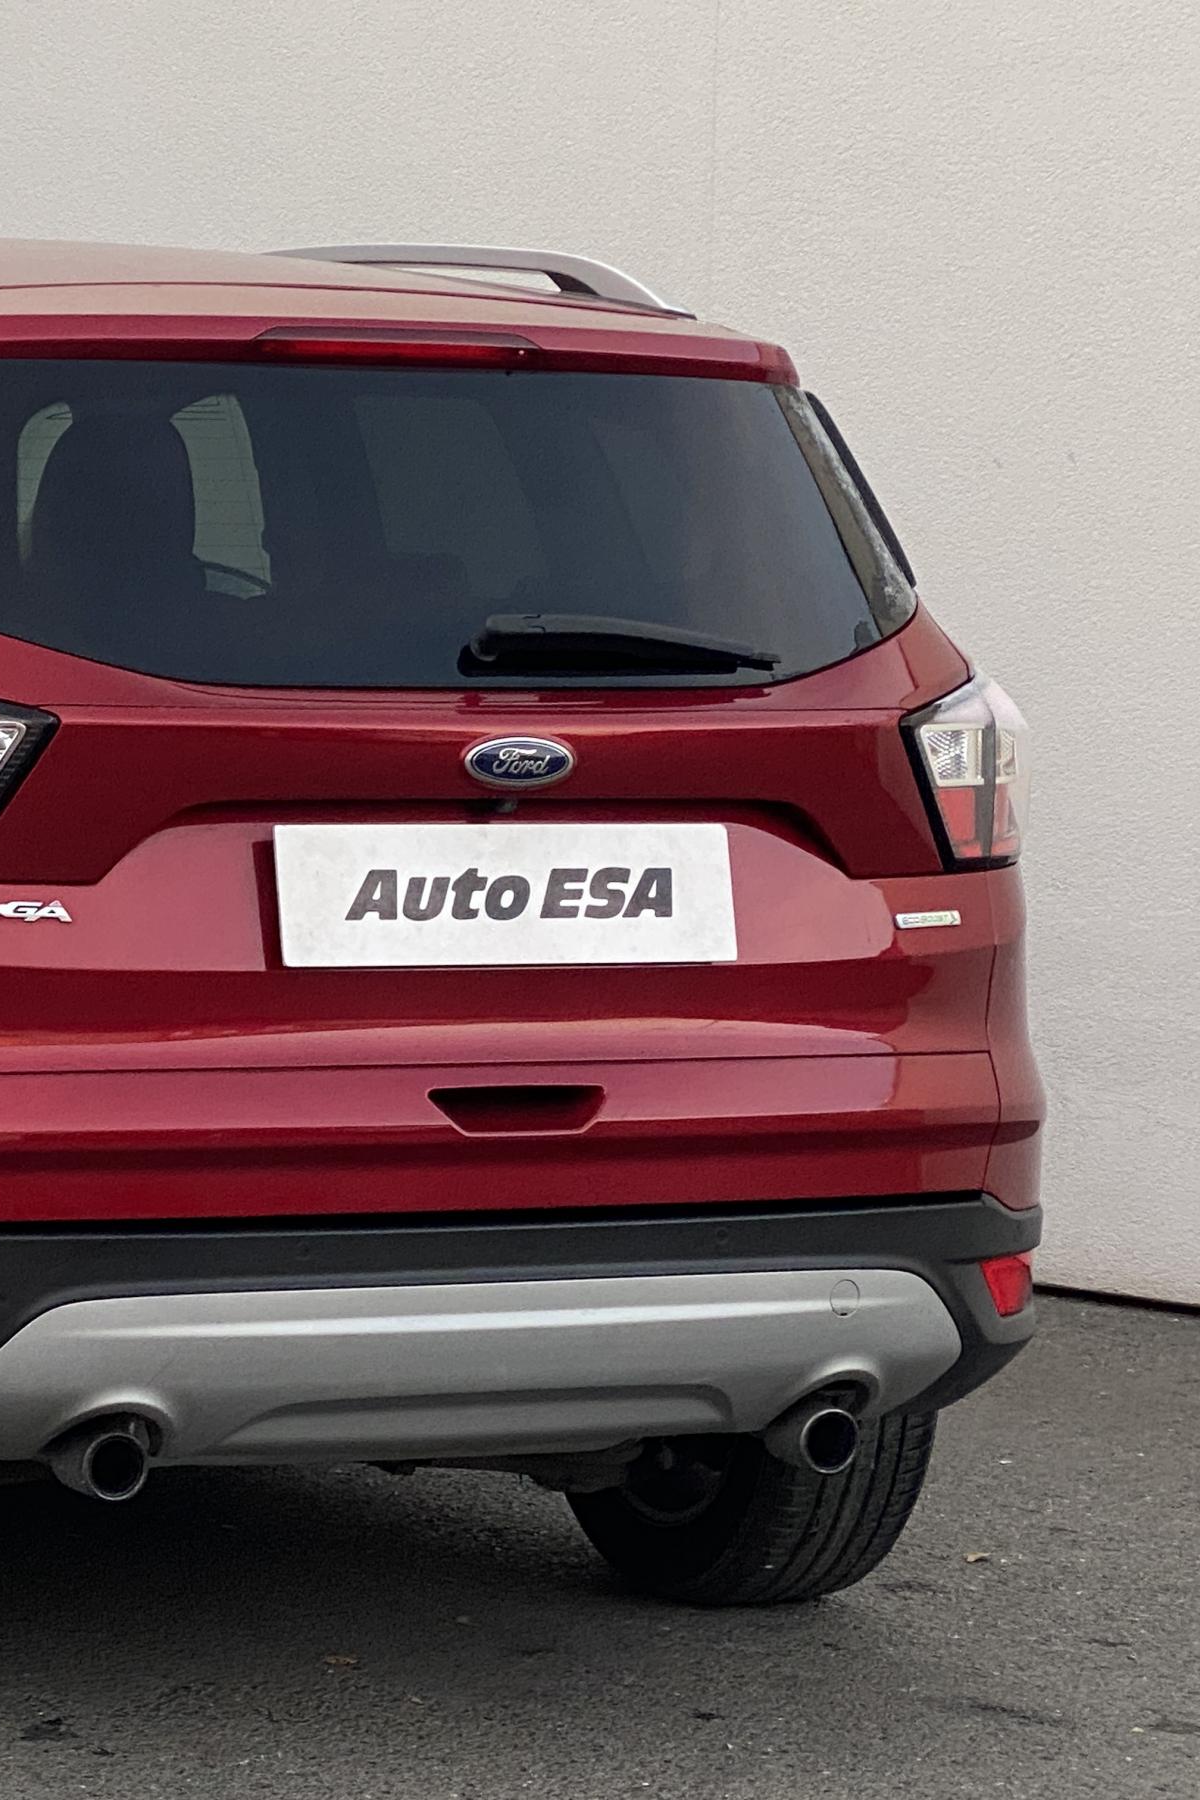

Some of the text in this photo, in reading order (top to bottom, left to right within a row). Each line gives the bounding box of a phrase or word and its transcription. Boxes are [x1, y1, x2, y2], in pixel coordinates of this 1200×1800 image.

[493, 748, 550, 773] Ford
[345, 867, 672, 920] Auto ESA
